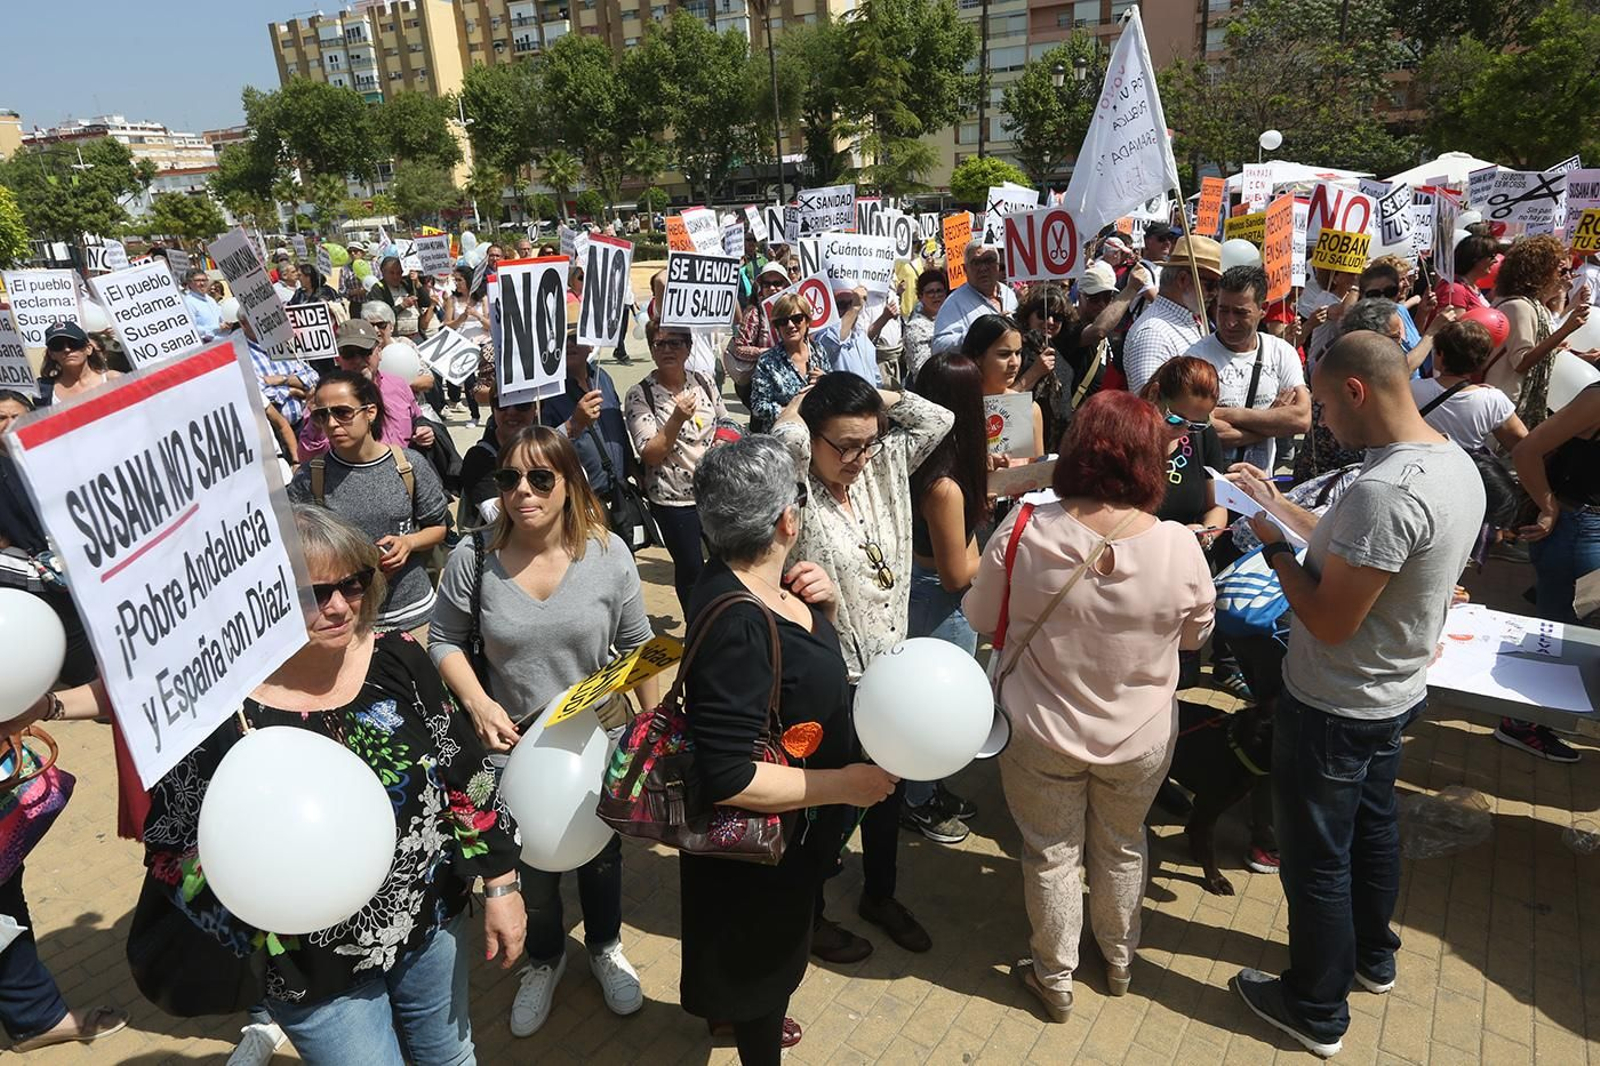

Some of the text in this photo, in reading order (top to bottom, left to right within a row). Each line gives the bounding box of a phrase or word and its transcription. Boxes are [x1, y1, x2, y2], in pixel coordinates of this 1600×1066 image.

[816, 194, 852, 210] SANIDAD
[1307, 183, 1371, 235] NO
[768, 208, 785, 241] N
[825, 241, 895, 261] ¿Cuántos más
[1005, 210, 1077, 277] NO
[1317, 232, 1371, 257] ROBAN
[1574, 236, 1592, 249] TU
[670, 257, 739, 284] SE VENDE
[800, 240, 820, 279] N
[827, 264, 891, 283] deben morir?
[1314, 250, 1328, 262] TU
[1328, 253, 1364, 269] SALUD!
[9, 278, 72, 295] ¡El pueblo
[104, 273, 171, 306] ¡El pueblo
[580, 245, 626, 340] NO
[13, 295, 75, 309] reclama:
[115, 294, 181, 323] reclama:
[668, 288, 733, 318] TU SALUD
[17, 313, 79, 326] Susana
[124, 313, 189, 342] Susana
[286, 307, 327, 329] ENDE
[500, 267, 566, 385] NO
[22, 331, 41, 343] NO
[133, 329, 199, 363] NO sana!
[418, 329, 481, 379] NO
[0, 366, 34, 384] ADA!
[66, 401, 254, 569] SUSANA NO SANA.
[115, 502, 272, 680] ¡Pobre Andalucía
[142, 565, 292, 753] y España con Díaz!
